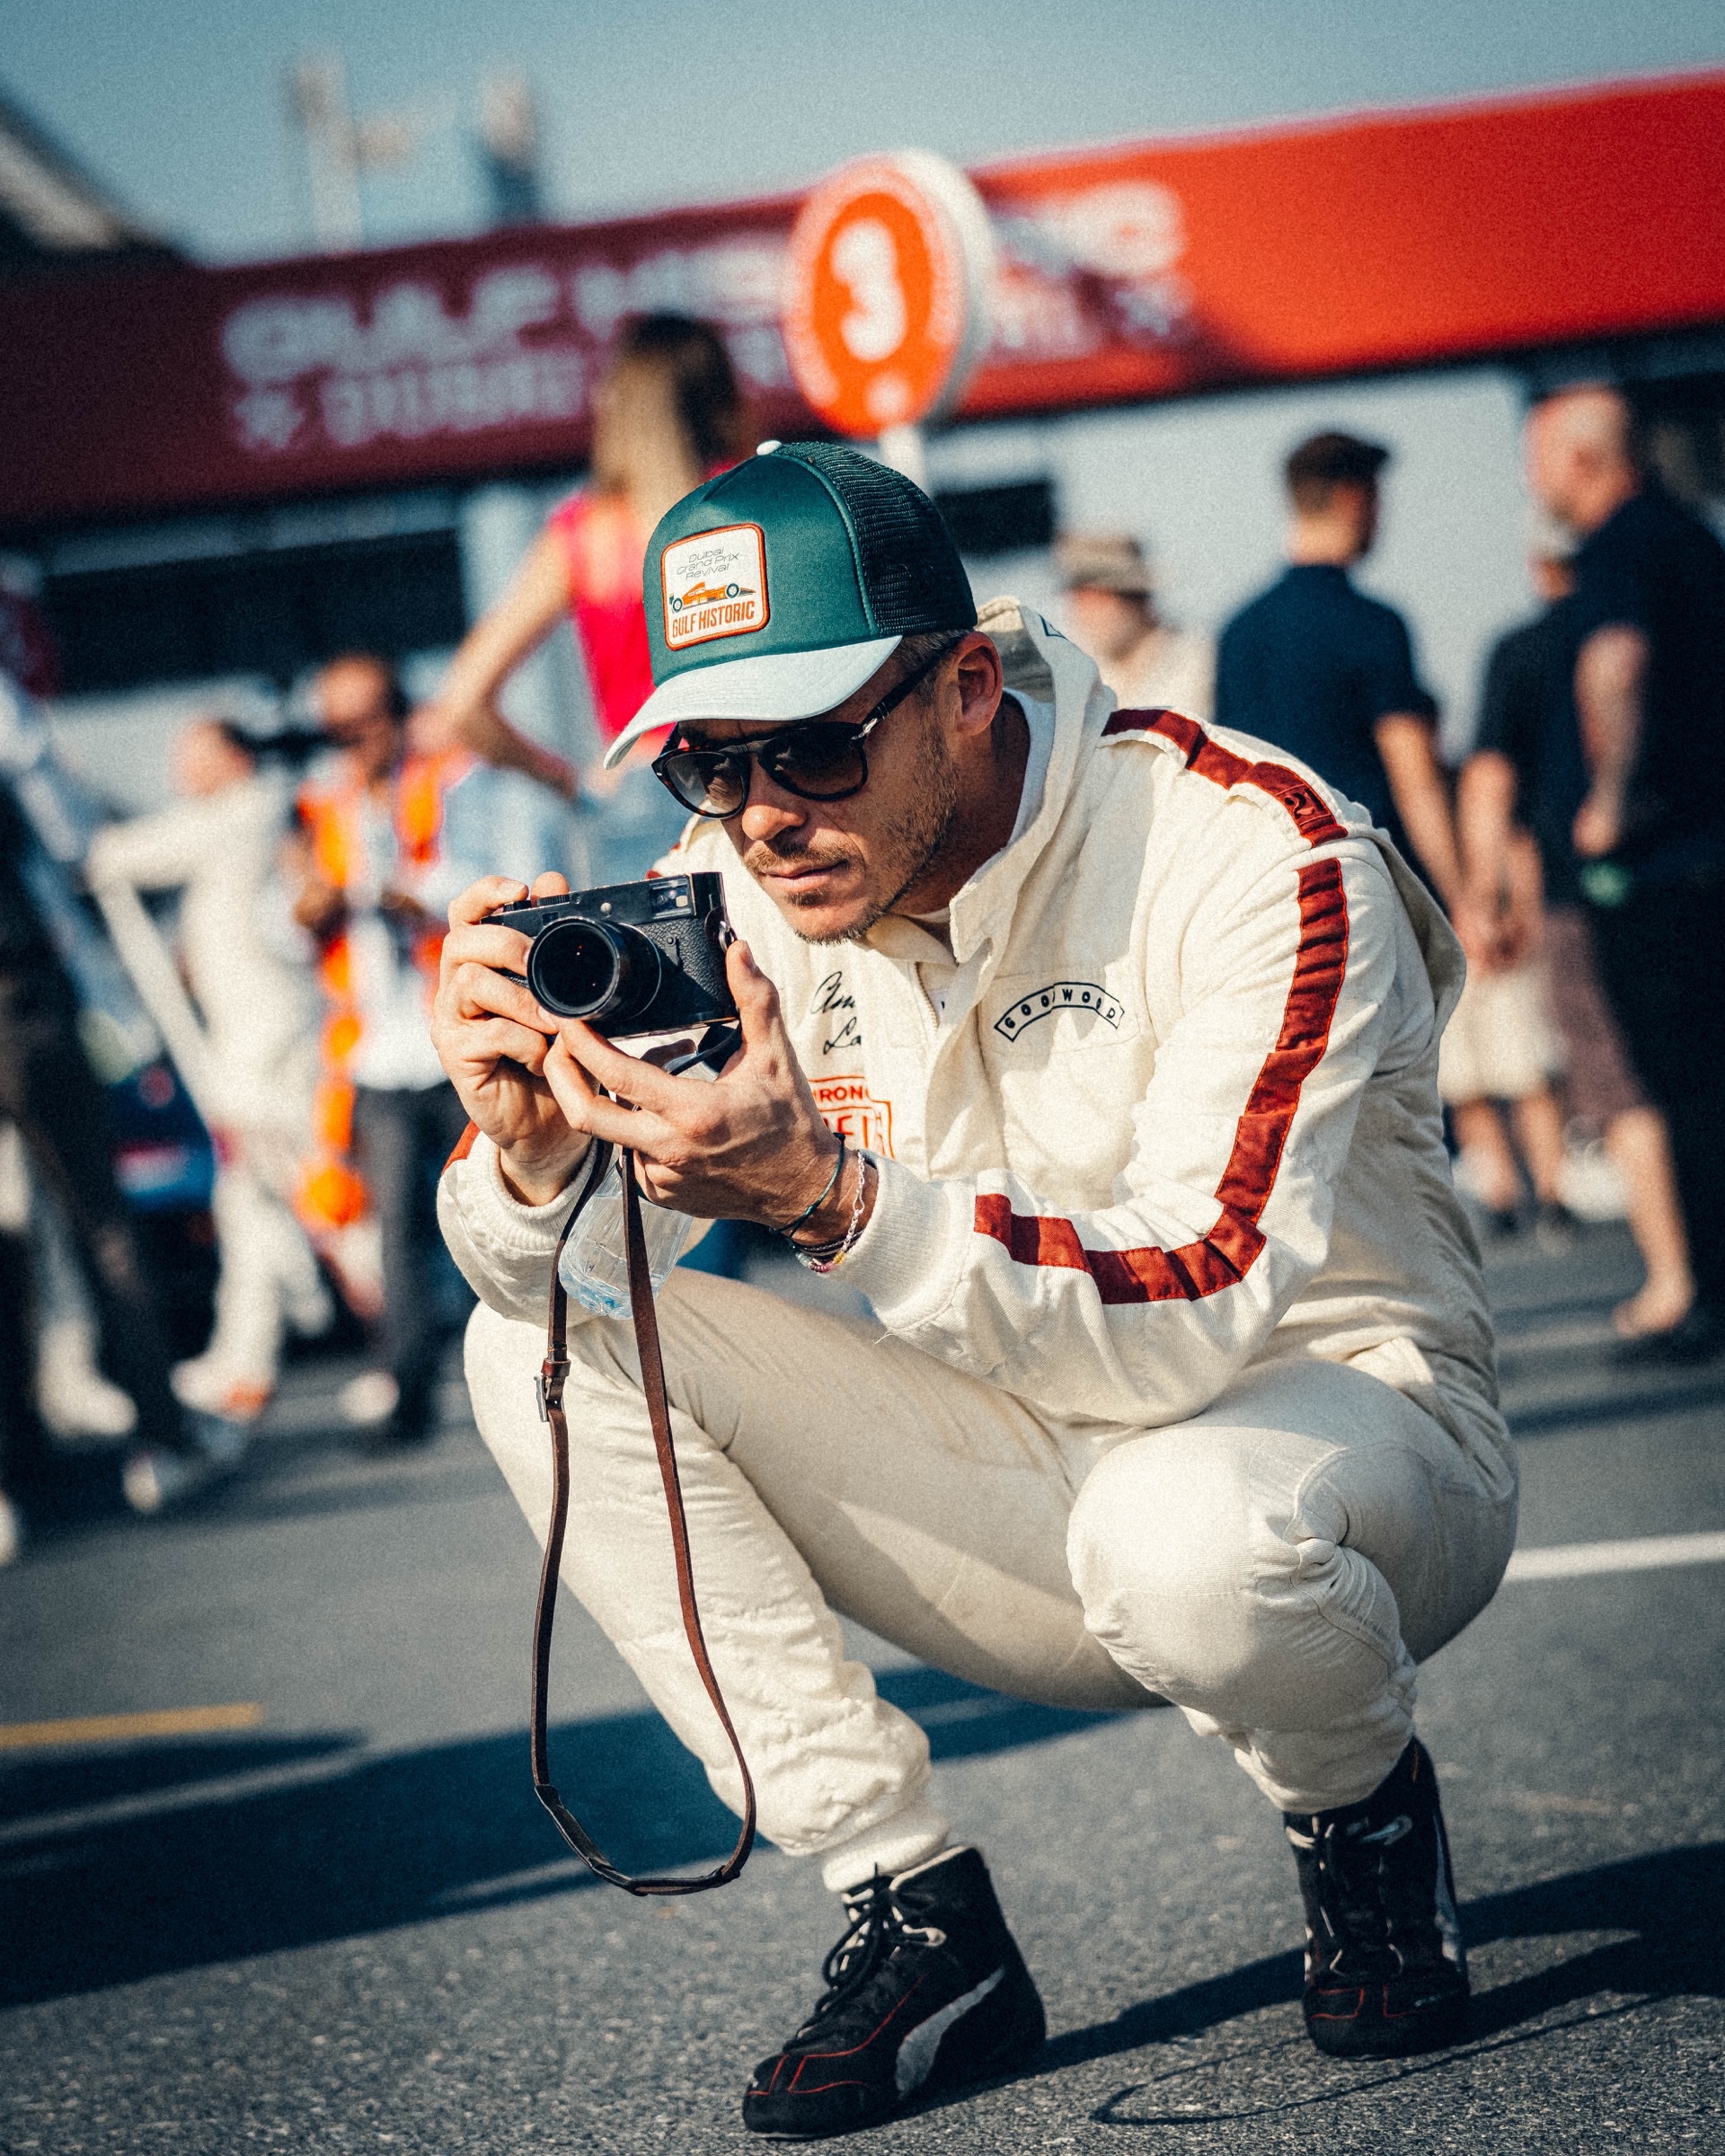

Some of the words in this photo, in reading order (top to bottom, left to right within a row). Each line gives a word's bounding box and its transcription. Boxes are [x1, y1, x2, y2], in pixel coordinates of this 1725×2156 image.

[832, 217, 907, 363] 3
[677, 558, 712, 575] Grand
[714, 552, 739, 564] Prix
[686, 562, 730, 580] Revival
[672, 613, 697, 638] GULF
[698, 600, 756, 630] HISTORIC
